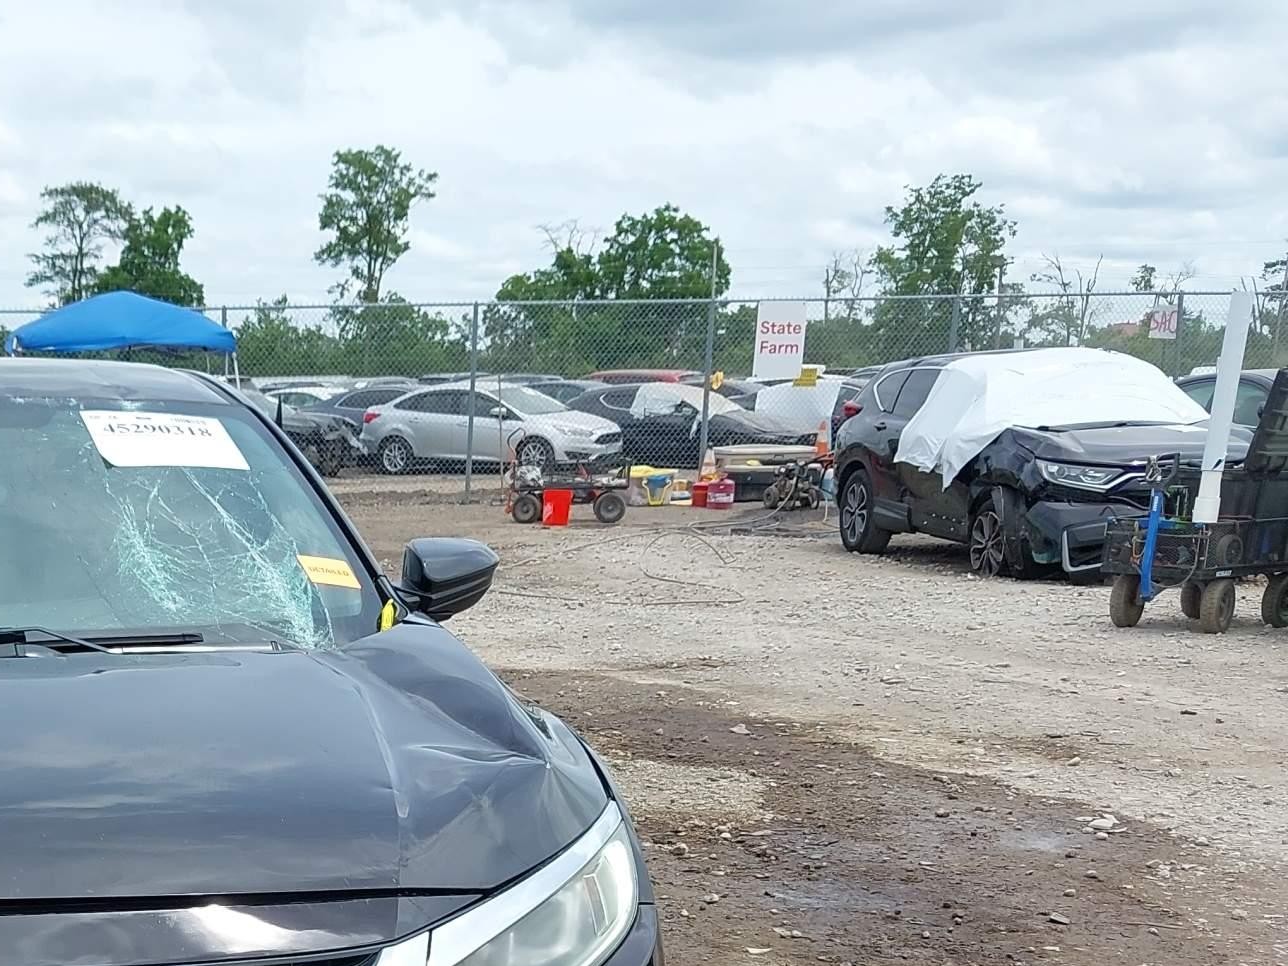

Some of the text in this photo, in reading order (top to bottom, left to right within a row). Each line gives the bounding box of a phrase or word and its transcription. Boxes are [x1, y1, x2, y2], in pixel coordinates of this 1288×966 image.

[760, 320, 802, 335] State
[759, 340, 799, 355] Farm
[103, 423, 213, 437] 45290318
